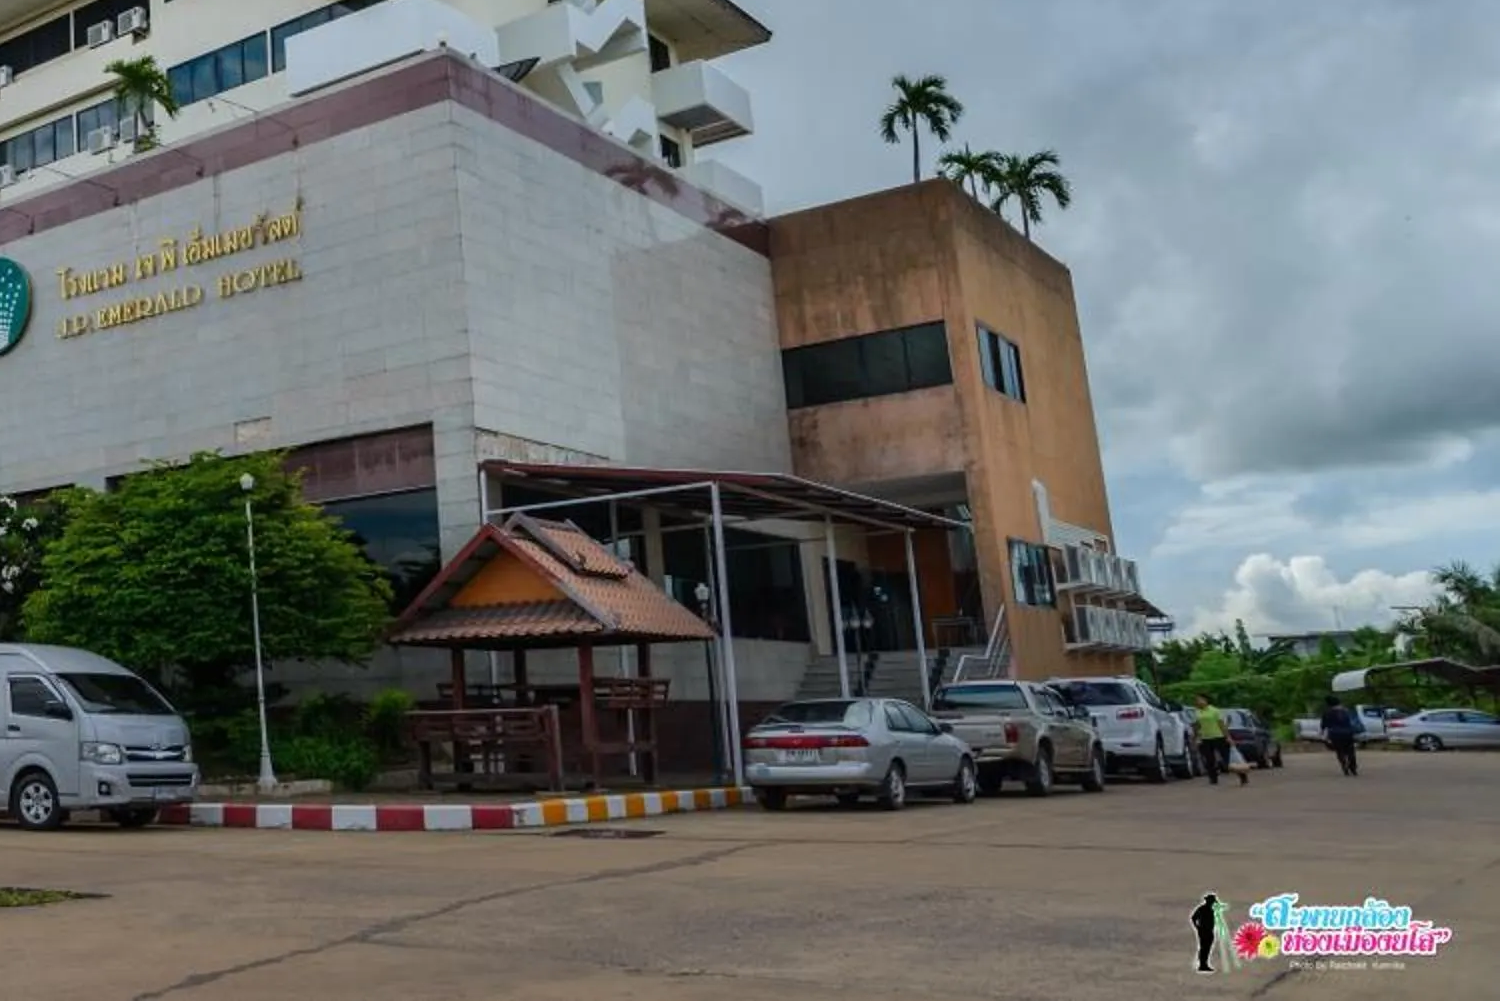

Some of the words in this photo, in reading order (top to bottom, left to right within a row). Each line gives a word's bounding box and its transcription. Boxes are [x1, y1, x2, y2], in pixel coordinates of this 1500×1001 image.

[55, 264, 127, 299] โรงแรม
[97, 284, 203, 329] EMERALD
[218, 258, 303, 298] HOTEL
